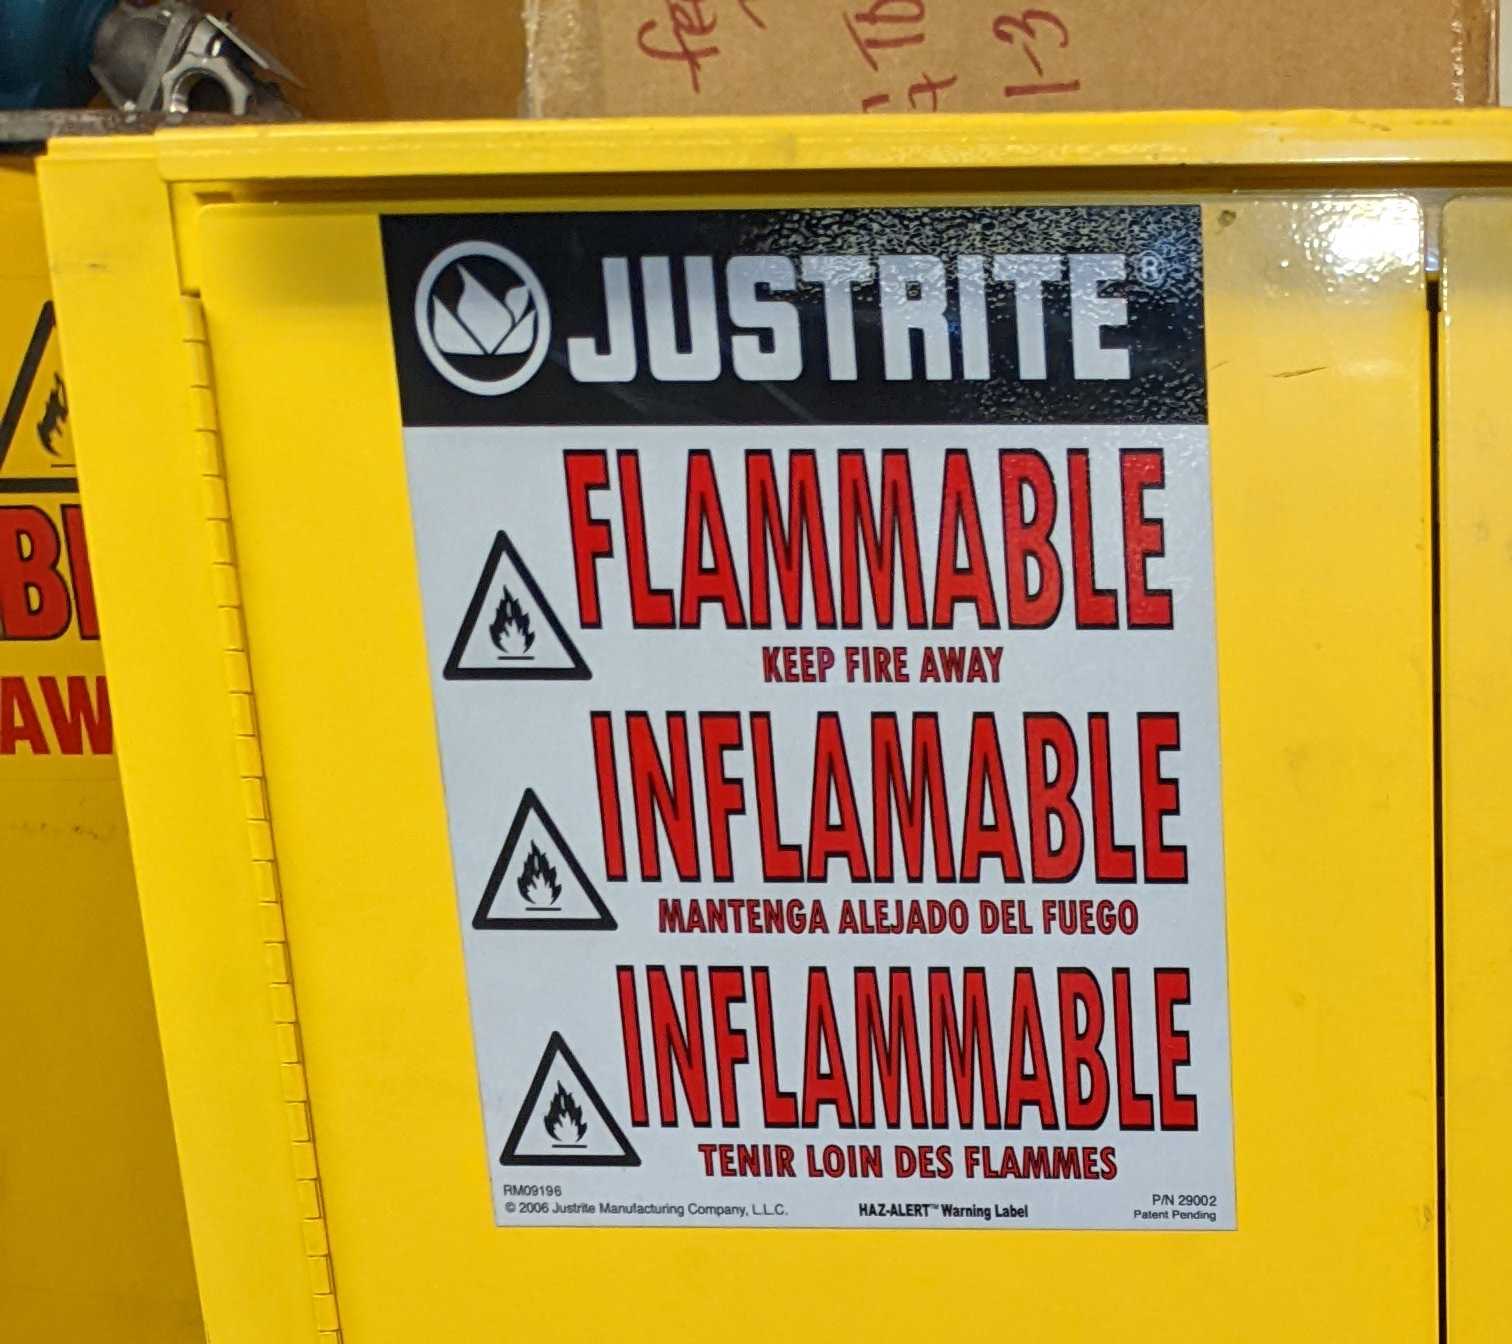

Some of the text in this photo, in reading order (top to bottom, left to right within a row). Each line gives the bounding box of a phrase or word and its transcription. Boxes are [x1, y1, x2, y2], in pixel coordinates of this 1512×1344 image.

[561, 447, 1175, 631] FLAMMABLE
[761, 645, 1005, 684] KEEP FIRE AWAY
[588, 710, 1189, 885] INFLAMABLE
[658, 897, 1140, 937] MANTENGA ALEJADO DEL FUEGO
[614, 963, 1200, 1132] INFLAMMABLE
[697, 1143, 1119, 1181] TENIR LOIN DES FLAMMES
[503, 1184, 563, 1197] RM09196
[1152, 1194, 1217, 1207] P/N 29002
[518, 1202, 550, 1214] 2006
[551, 1202, 596, 1215] Justrite
[599, 1203, 685, 1218] Manufacturing
[687, 1204, 749, 1218] Company,
[751, 1204, 790, 1216] L.L.C.
[941, 1204, 992, 1221] Warning
[994, 1205, 1029, 1219] Label
[1133, 1209, 1217, 1223] Patent Pending
